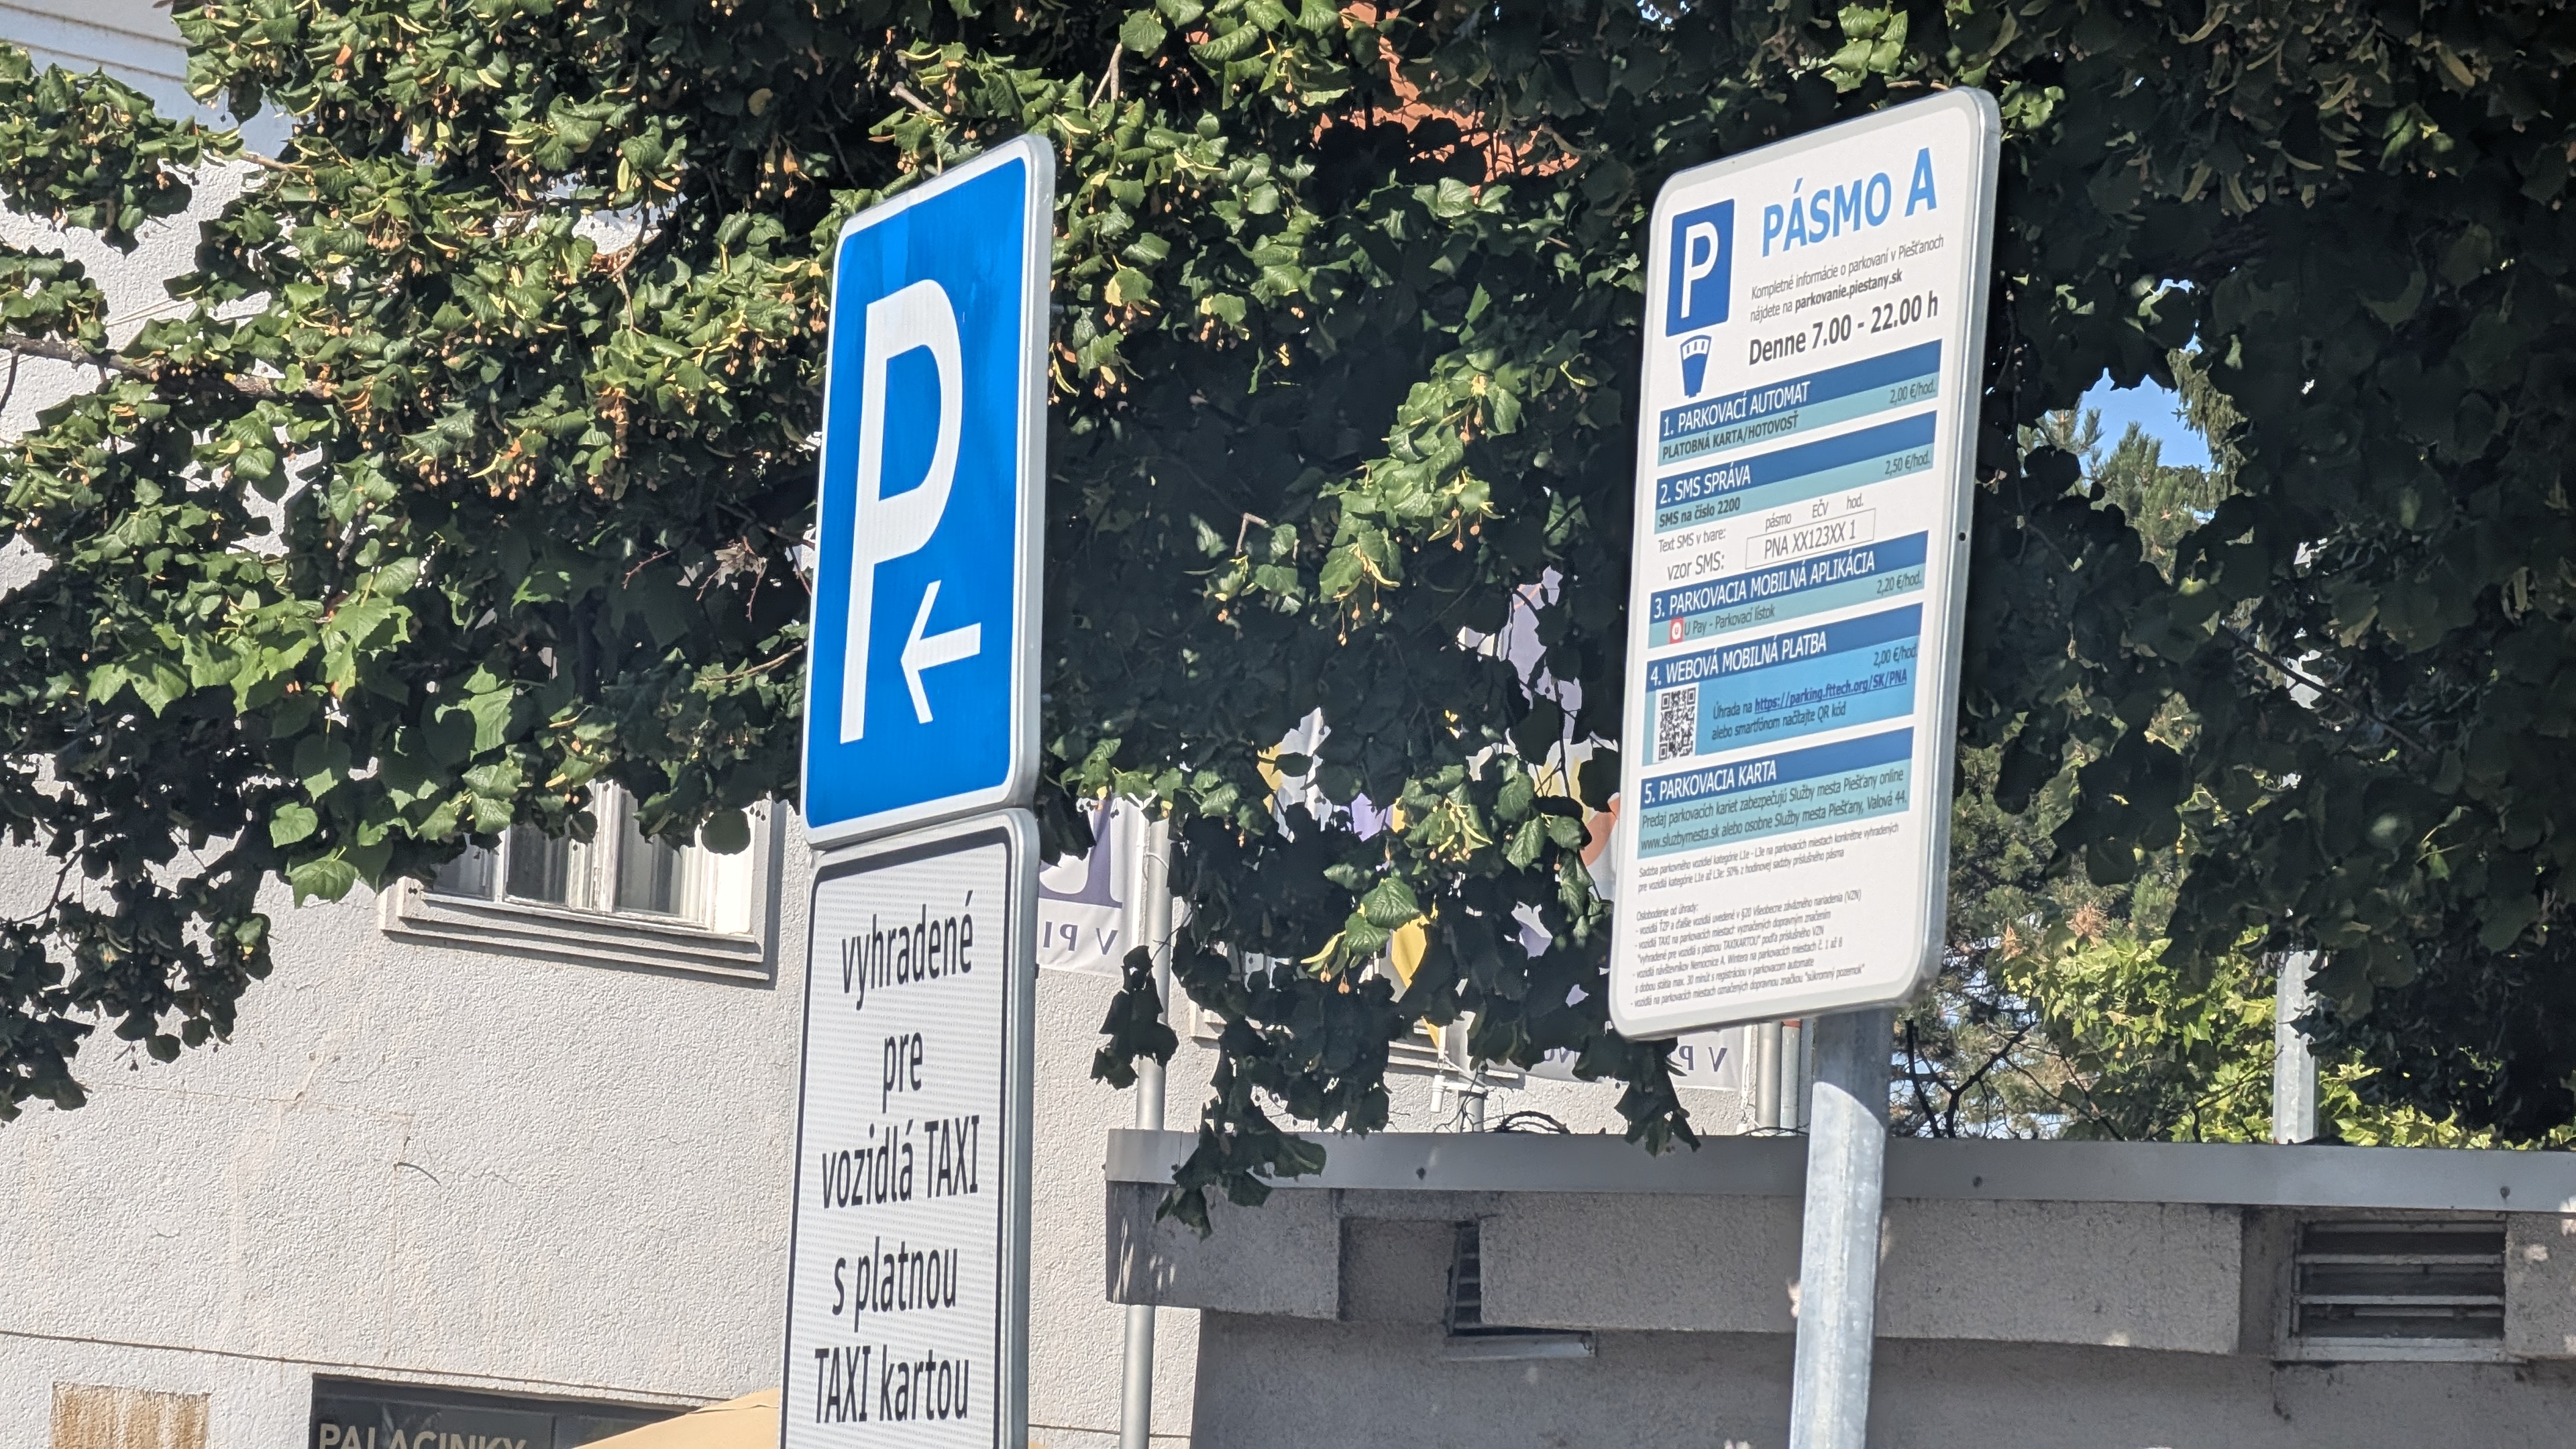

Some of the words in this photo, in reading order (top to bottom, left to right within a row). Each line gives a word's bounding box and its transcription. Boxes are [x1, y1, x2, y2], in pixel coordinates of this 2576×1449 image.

[1762, 172, 1891, 257] PÁSMO
[1904, 147, 1937, 217] A
[1680, 221, 1718, 318] P
[1751, 274, 1793, 300] Kompletné
[1796, 264, 1838, 287] informácie
[1840, 264, 1845, 275] o
[1848, 247, 1888, 276] parkovaní
[1890, 250, 1896, 261] v
[1898, 233, 1943, 259] Piešťanoch
[1750, 303, 1780, 323] nájdete
[1782, 301, 1792, 313] na
[1794, 268, 1902, 313] parkovanie.piestany.sk
[1749, 332, 1806, 365] Denne
[1812, 314, 1851, 349] 7.00
[1870, 294, 1921, 333] 22.00
[1927, 290, 1937, 317] h
[1663, 416, 1673, 436] 1.
[1678, 390, 1748, 432] PARKOVACÍ
[1749, 380, 1810, 415] AUTOMAT
[1889, 386, 1907, 405] 2,00
[1909, 378, 1935, 399] €/hod.
[1662, 431, 1710, 460] PLATOBNÁ
[1712, 410, 1799, 447] KARTA/HOTOVOSŤ
[1660, 484, 1670, 504] 2.
[1674, 476, 1701, 500] SMS
[1703, 457, 1752, 494] SPRÁVA
[1884, 457, 1902, 476] 2,50
[1904, 450, 1930, 471] €/hod.
[840, 279, 963, 744] P
[1659, 511, 1678, 527] SMS
[1680, 511, 1692, 523] na
[1694, 503, 1715, 519] číslo
[1717, 496, 1740, 514] 2200
[1765, 513, 1791, 532] pásmo
[1812, 498, 1829, 518] EČV
[1846, 492, 1863, 509] hod.
[1658, 537, 1674, 552] Text
[1676, 532, 1694, 549] SMS
[1696, 534, 1701, 544] v
[1703, 529, 1725, 543] tvare:
[1667, 561, 1692, 580] vzor
[1695, 550, 1724, 575] SMS:
[1764, 535, 1788, 559] PNA
[1792, 521, 1845, 553] XX123XX
[1849, 519, 1855, 539] 1
[1654, 597, 1664, 619] 3.
[1669, 580, 1746, 615] PARKOVACIA
[1750, 559, 1807, 598] MOBILNÁ
[1809, 544, 1874, 584] APLIKÁCIA
[1876, 576, 1894, 595] 2,20
[1684, 622, 1690, 635] U
[1693, 620, 1707, 635] Pay
[1715, 607, 1752, 629] Parkovací
[1754, 604, 1774, 621] lístok
[1650, 666, 1661, 686] 4.
[1666, 647, 1720, 683] WEBOVÁ
[1722, 634, 1780, 672] MOBILNÁ
[1782, 631, 1826, 659] PLATBA
[1873, 649, 1890, 668] 2,00
[1711, 724, 1732, 740] alebo
[1734, 716, 1780, 736] smartfónom
[1782, 708, 1815, 727] načítajte
[1817, 704, 1829, 722] QR
[1831, 700, 1846, 717] kód
[1713, 701, 1740, 719] Úhrada
[1742, 702, 1752, 713] na
[1642, 811, 1666, 828] Predaj
[1668, 802, 1713, 827] parkovacích
[1715, 799, 1737, 814] kariet
[1739, 788, 1786, 811] zabezpečujú
[1788, 784, 1815, 802] Služby
[1817, 780, 1841, 796] mesta
[1843, 774, 1878, 792] Piešťany
[1879, 769, 1903, 785] online
[1644, 782, 1655, 804] 5.
[1659, 767, 1734, 800] PARKOVACIA
[1738, 759, 1776, 786] KARTA
[1641, 824, 1719, 850] www.sluzbymesta.sk
[1721, 820, 1742, 837] alebo
[1744, 816, 1772, 833] osobne
[1774, 810, 1800, 827] Služby
[1802, 806, 1825, 821] mesta
[1828, 800, 1864, 816] Piešťany,
[1867, 790, 1892, 810] Valová
[1894, 790, 1907, 804] 44.
[842, 891, 973, 1011] vyhradené
[883, 1030, 923, 1113] pre
[822, 1118, 913, 1209] vozidlá
[924, 1114, 979, 1197] TAXI
[833, 1256, 845, 1316] s
[855, 1236, 957, 1333] platnou
[815, 1345, 869, 1424] TAXI
[880, 1342, 969, 1423] kartou
[319, 1423, 527, 1449] PALAC
